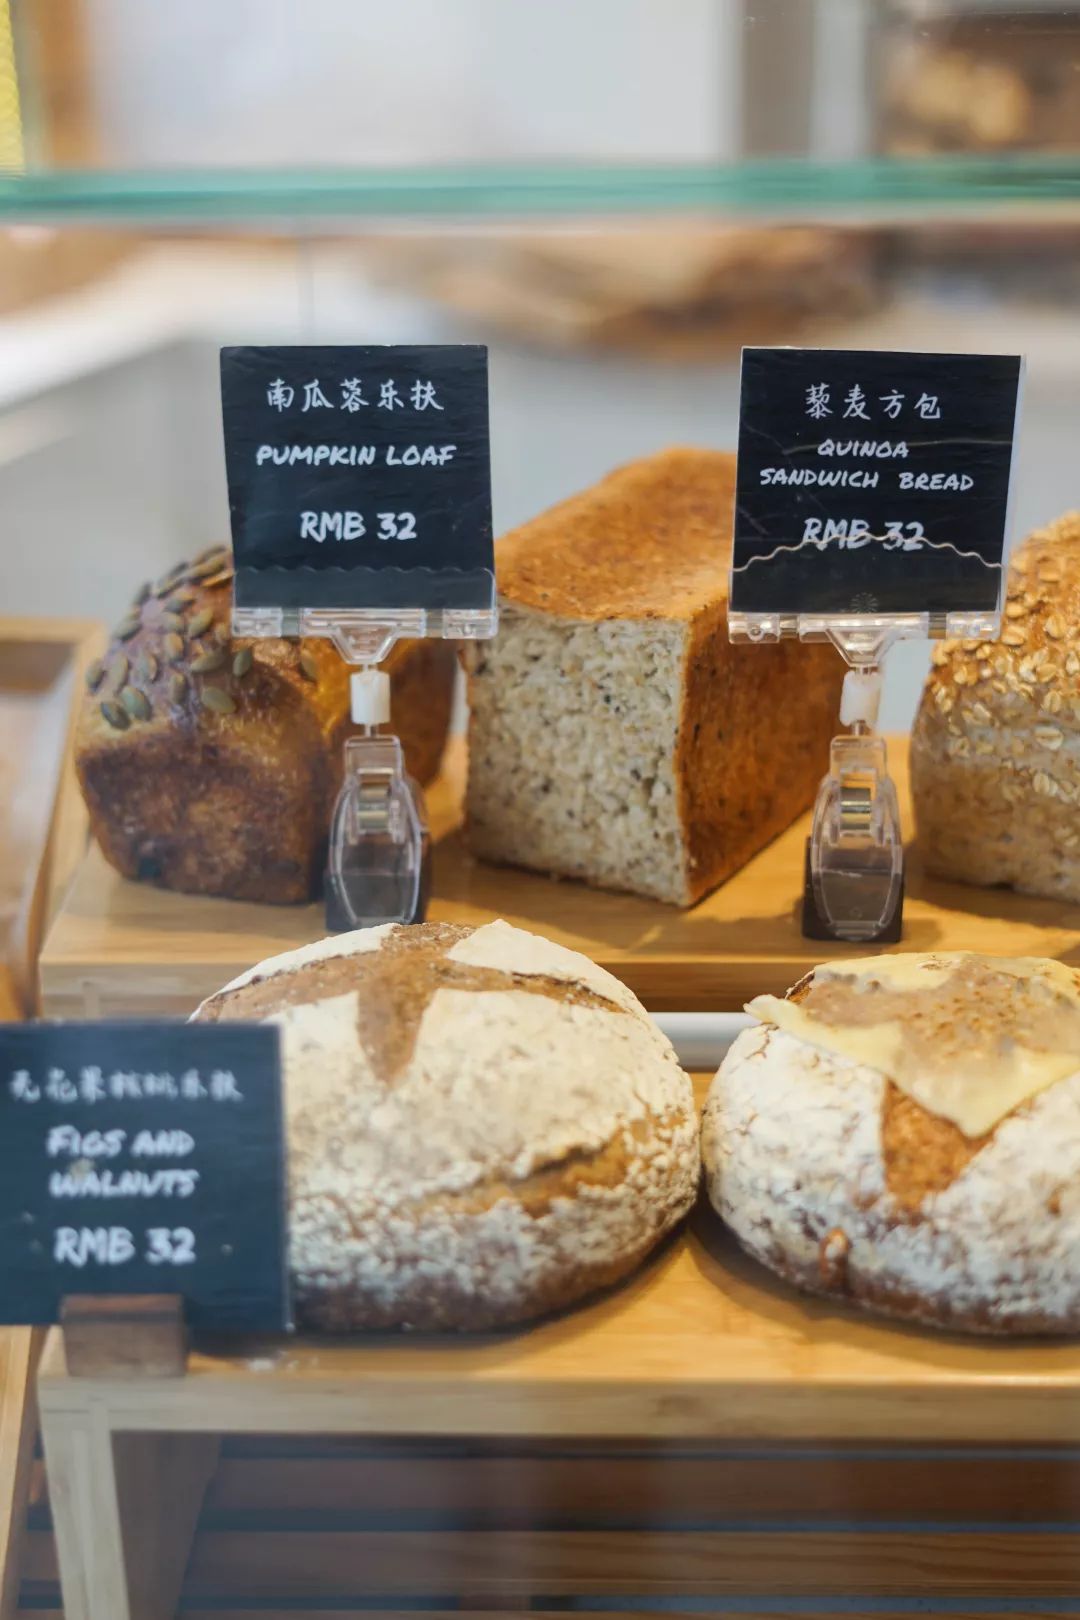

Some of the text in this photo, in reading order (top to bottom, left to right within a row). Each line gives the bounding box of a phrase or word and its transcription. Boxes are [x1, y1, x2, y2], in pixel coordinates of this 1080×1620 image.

[267, 378, 444, 413] 南瓜蓉乐扶
[805, 383, 941, 420] 藜麦方包
[256, 445, 457, 466] PUMPKIN LOAF
[817, 439, 909, 458] QUINOA
[760, 468, 974, 491] SANDWICH BREAD
[300, 511, 417, 542] RMB 32
[802, 517, 925, 551] RMB 32
[47, 1125, 195, 1157] FIGS AND
[49, 1169, 199, 1198] WALNUTS
[54, 1226, 197, 1267] RMB 32
